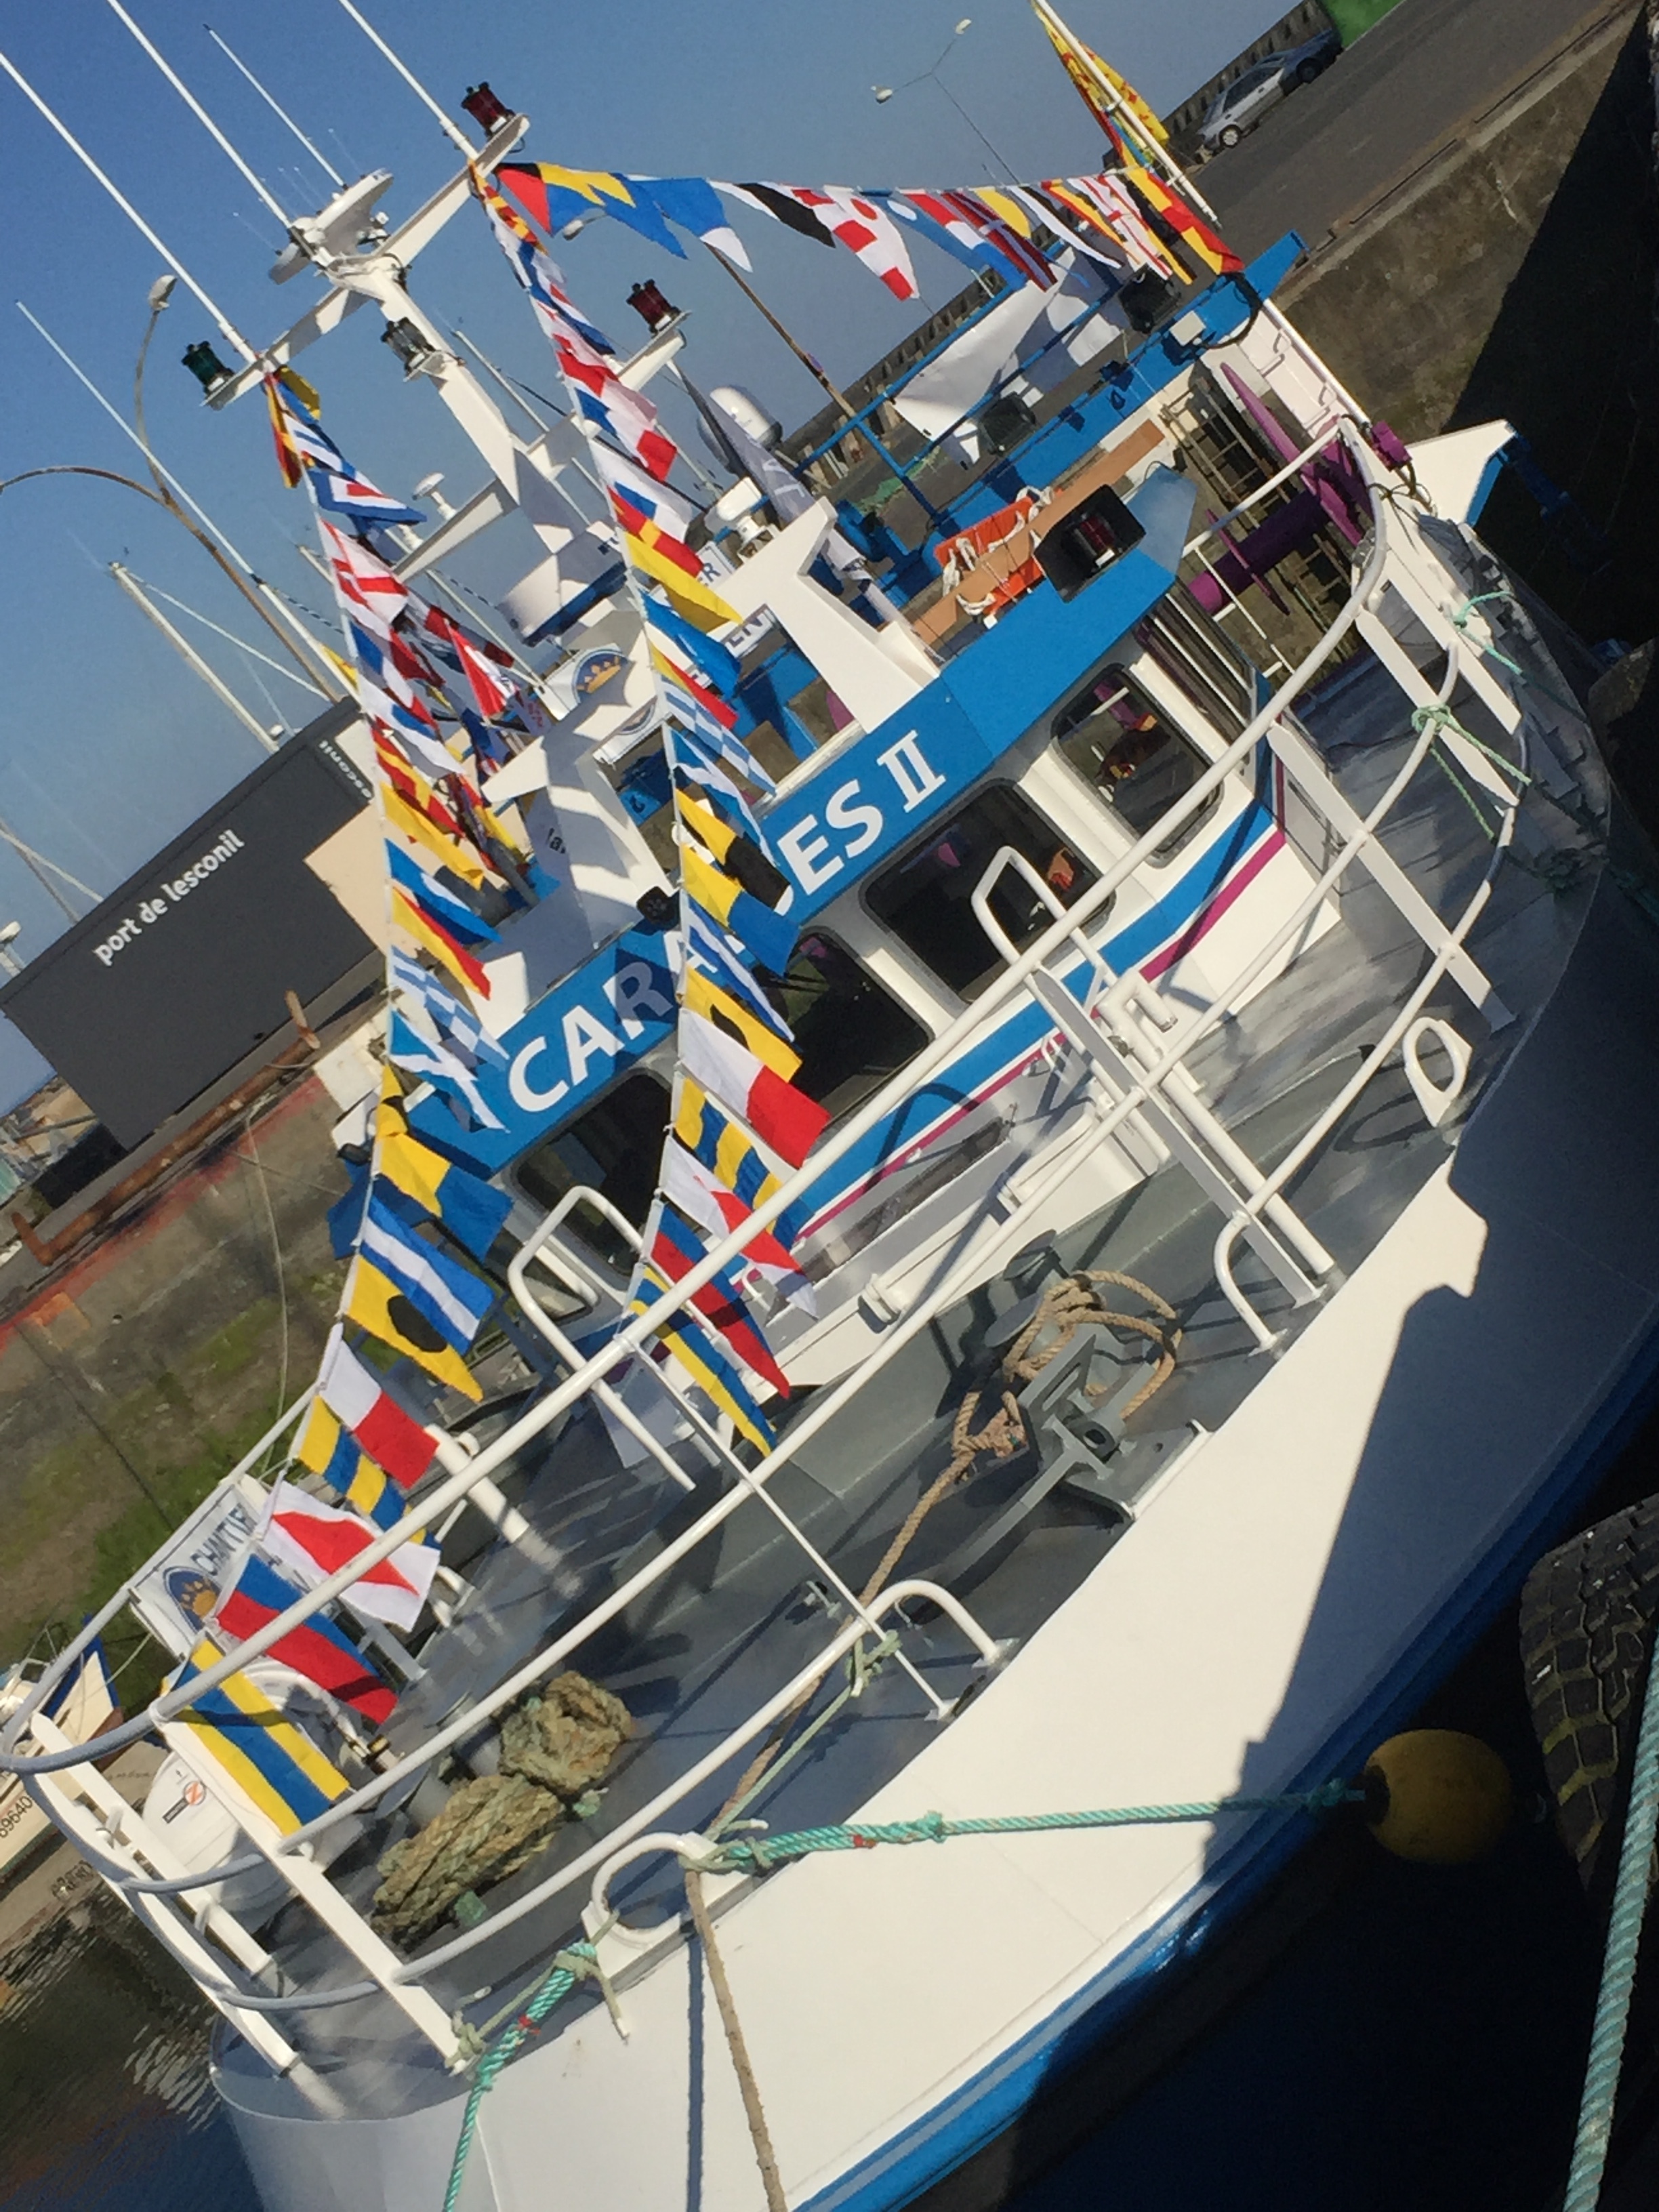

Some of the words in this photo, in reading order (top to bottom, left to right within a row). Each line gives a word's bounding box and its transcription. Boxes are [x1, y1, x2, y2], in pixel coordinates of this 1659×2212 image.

[319, 740, 372, 798] esconil
[92, 918, 142, 966] port
[138, 898, 168, 924] de
[160, 829, 245, 901] lesconil
[508, 779, 884, 1113] CARAES
